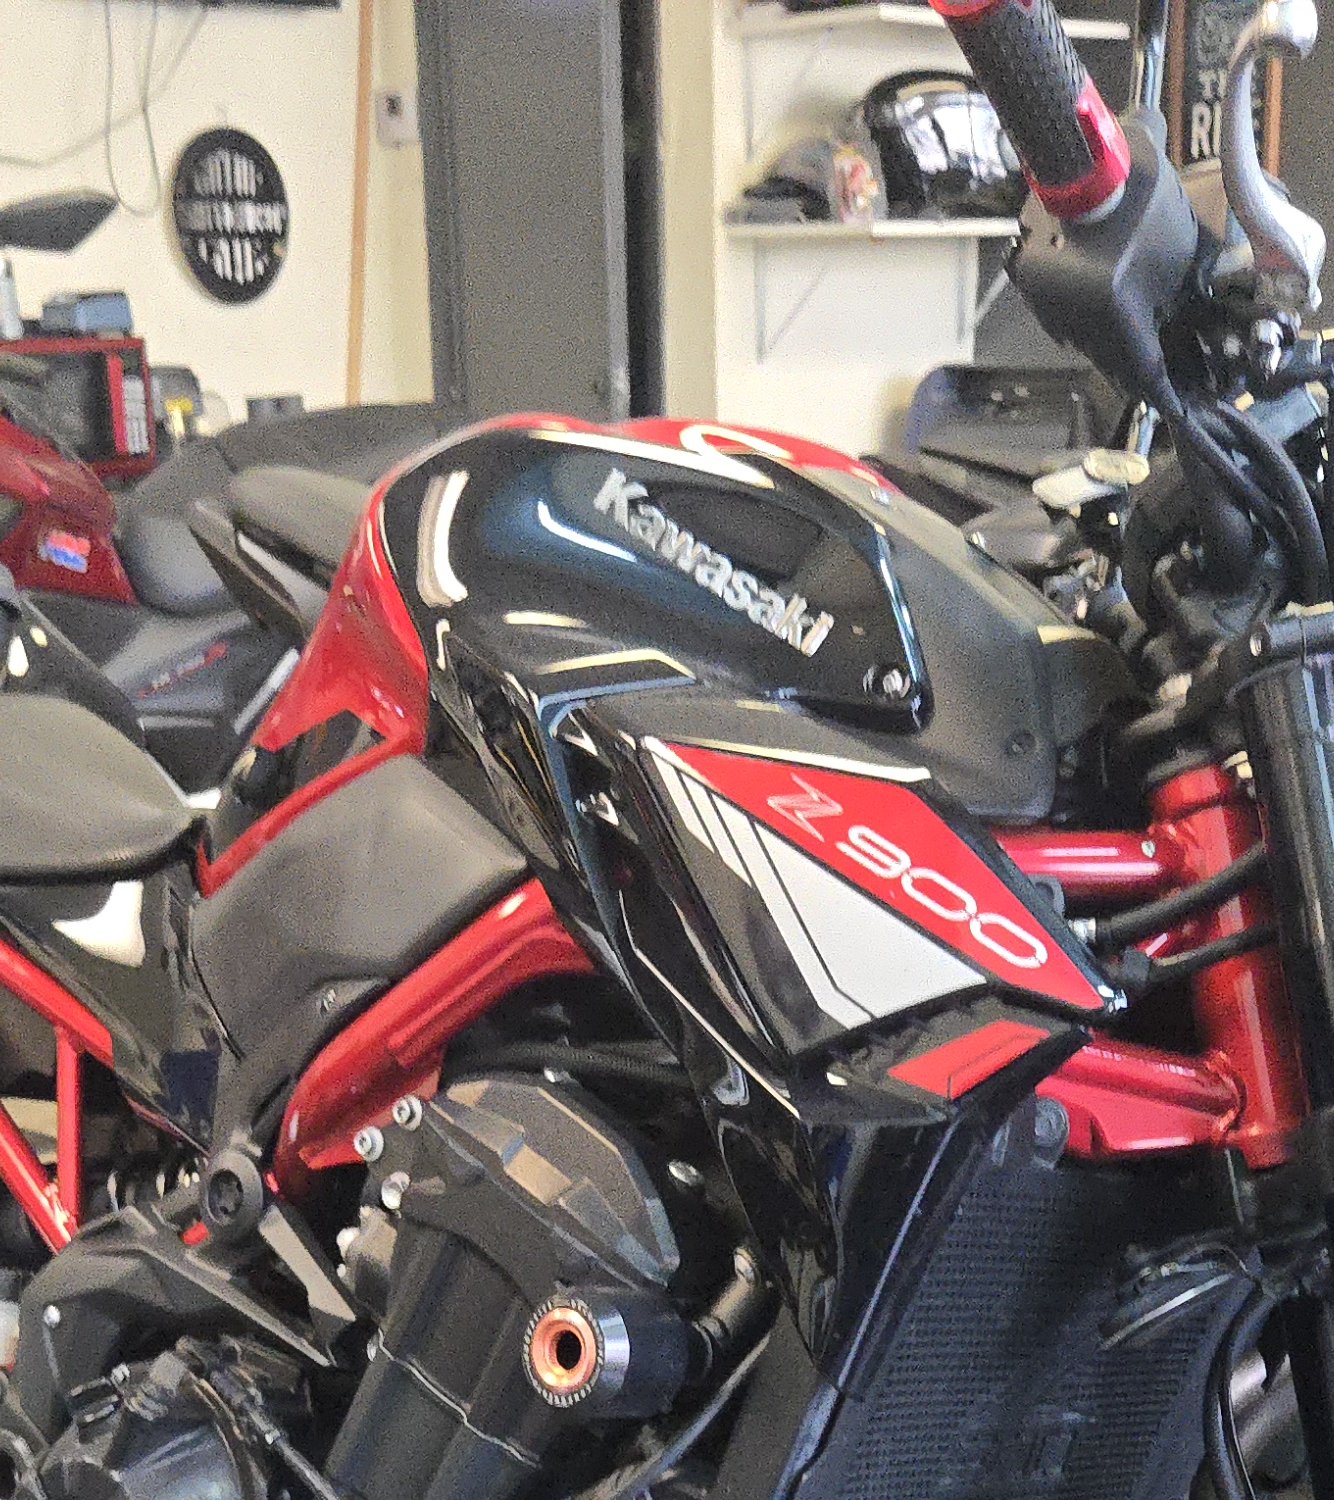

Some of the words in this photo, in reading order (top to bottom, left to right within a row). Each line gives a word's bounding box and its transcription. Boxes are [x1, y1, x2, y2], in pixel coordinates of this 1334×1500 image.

[593, 468, 835, 657] Kawasaki
[766, 772, 844, 843] Z
[835, 824, 1049, 969] 900
